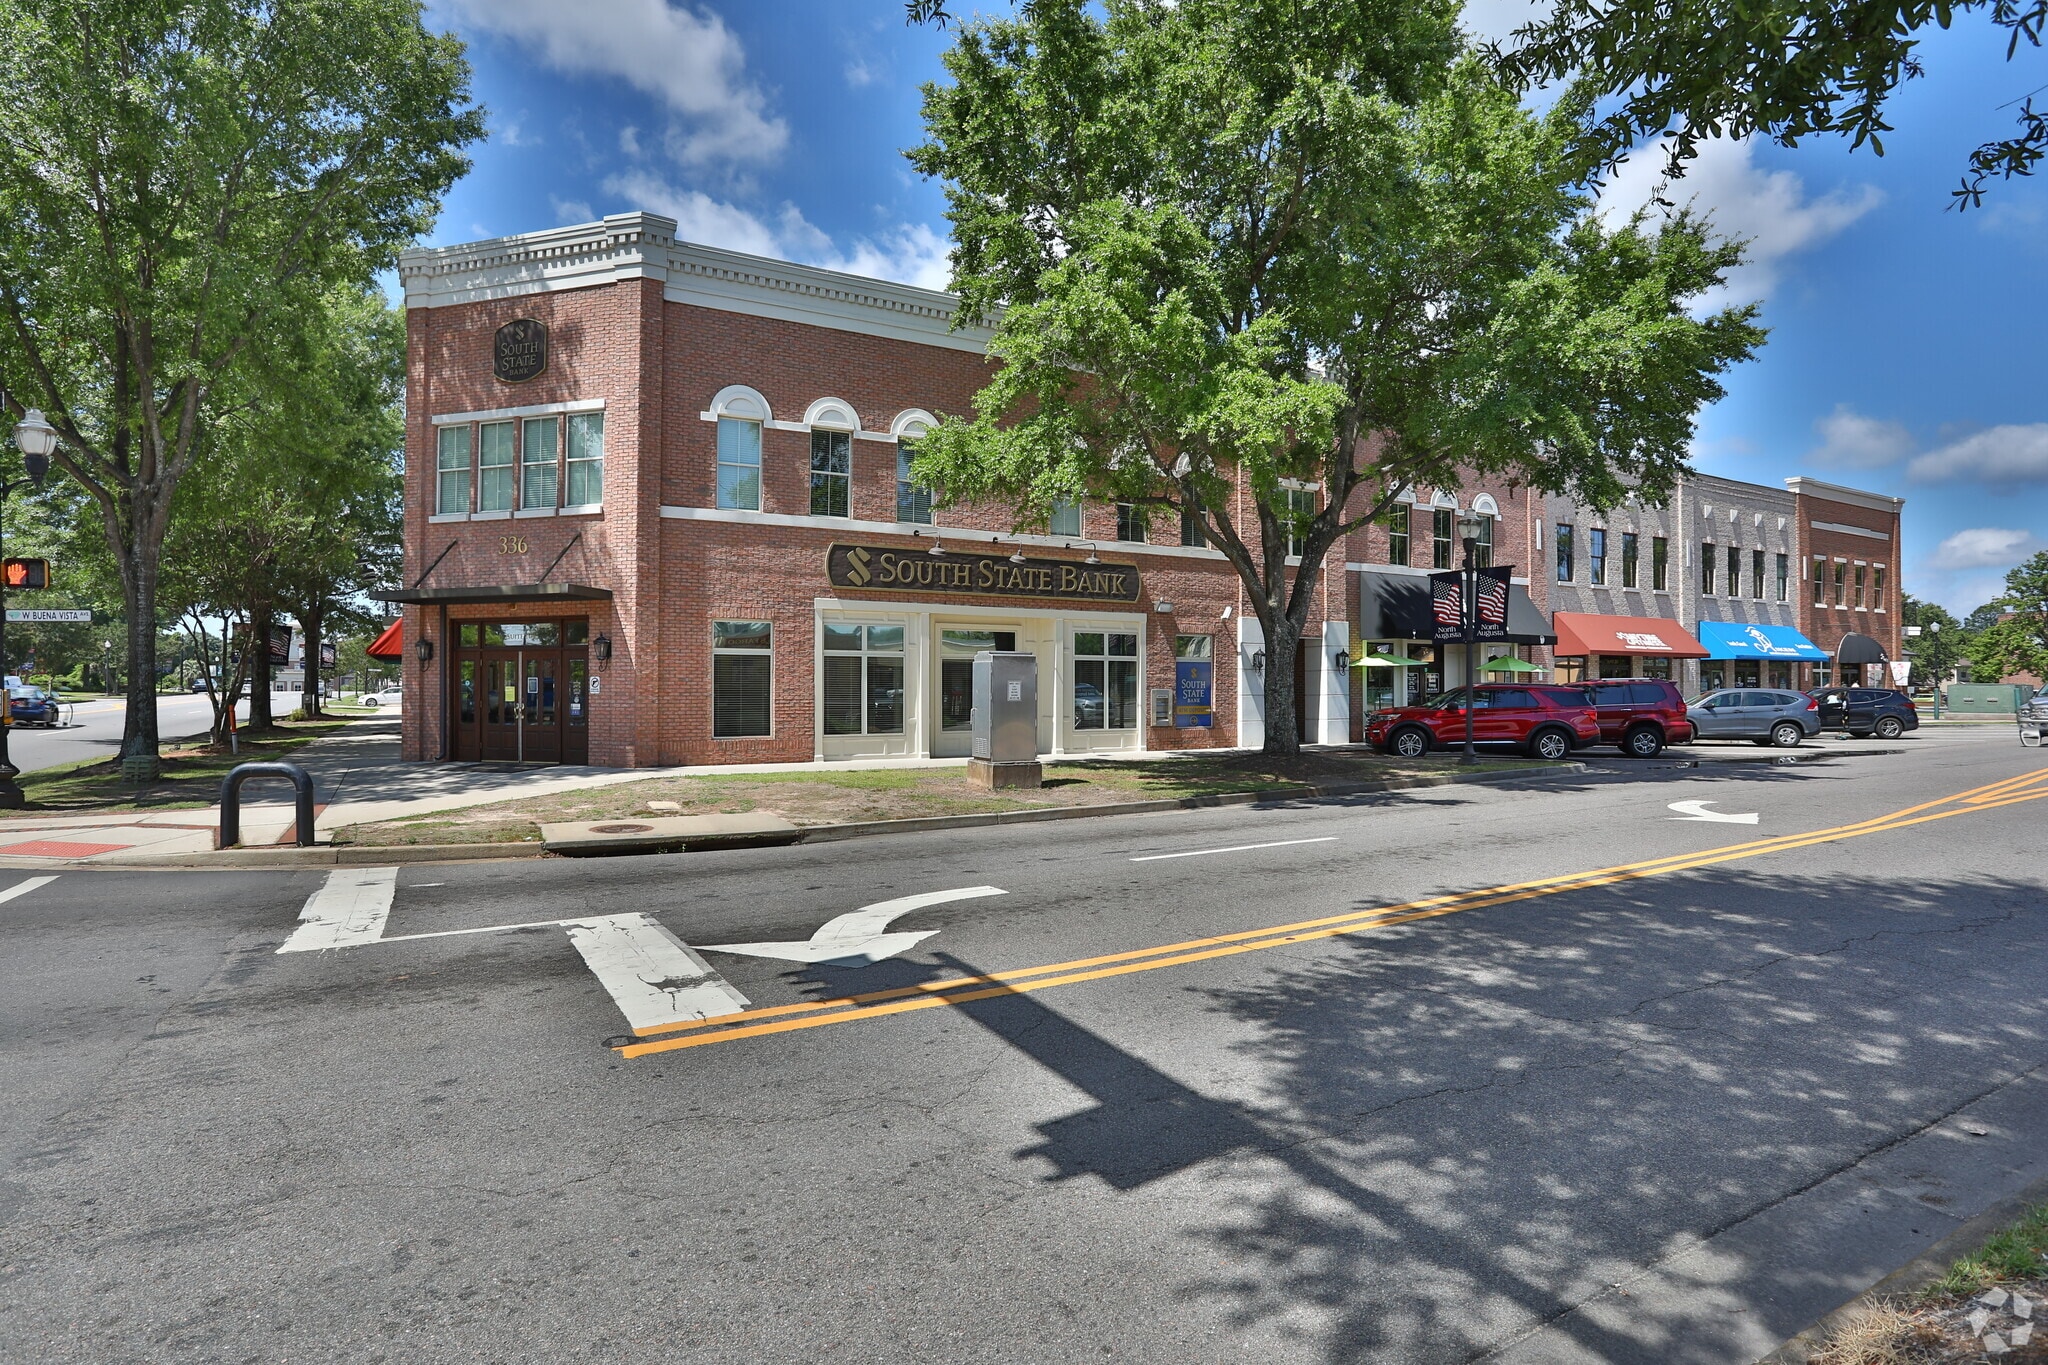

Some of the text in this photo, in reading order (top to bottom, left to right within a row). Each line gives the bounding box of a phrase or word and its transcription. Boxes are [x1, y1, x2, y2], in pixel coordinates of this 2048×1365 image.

[500, 341, 539, 357] SOUTH
[502, 355, 537, 371] STATE
[509, 368, 529, 376] BANK
[498, 535, 528, 555] 336
[879, 552, 1127, 595] SOUTH STATE BANK
[22, 612, 30, 620] W
[32, 611, 57, 620] BUENA
[59, 611, 79, 620] VISTA
[1437, 626, 1457, 634] North
[1480, 623, 1500, 631] North
[1434, 631, 1462, 640] Augusta
[1476, 629, 1505, 638] Augusta
[1181, 678, 1206, 689] SOUTH
[1182, 689, 1205, 700] STATE
